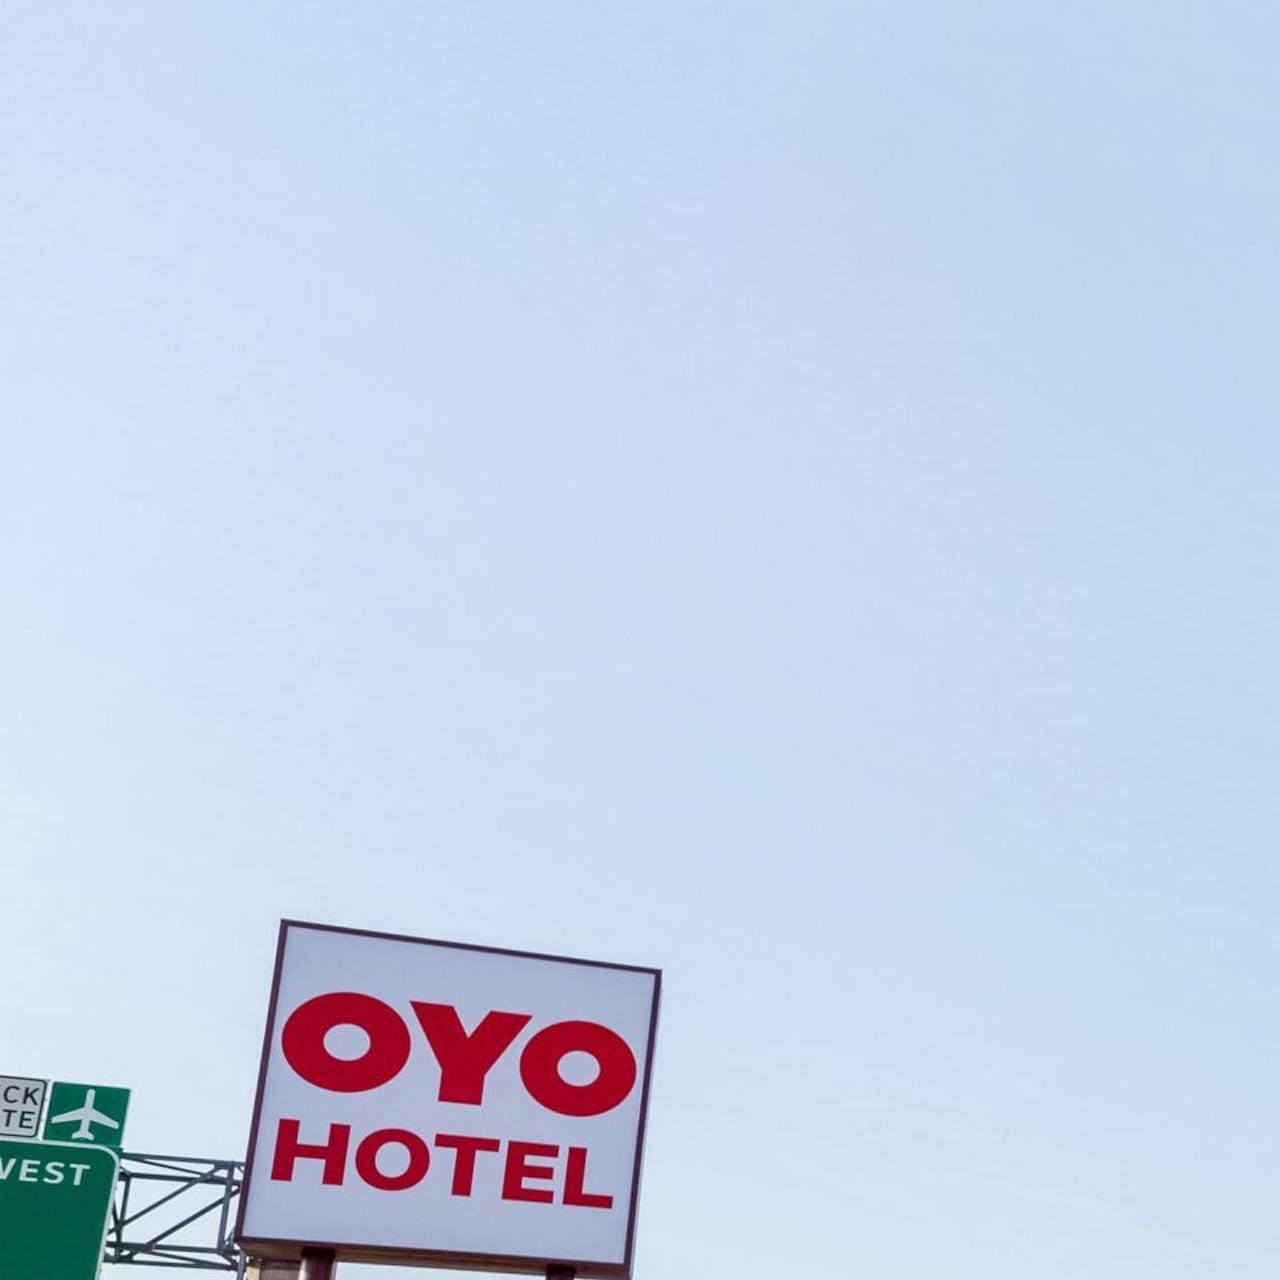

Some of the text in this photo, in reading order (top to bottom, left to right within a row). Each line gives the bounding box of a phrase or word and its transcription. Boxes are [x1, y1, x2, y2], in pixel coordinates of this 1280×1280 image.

[0, 1085, 39, 1106] CK
[281, 991, 638, 1118] OYO
[270, 1117, 614, 1209] HOTEL
